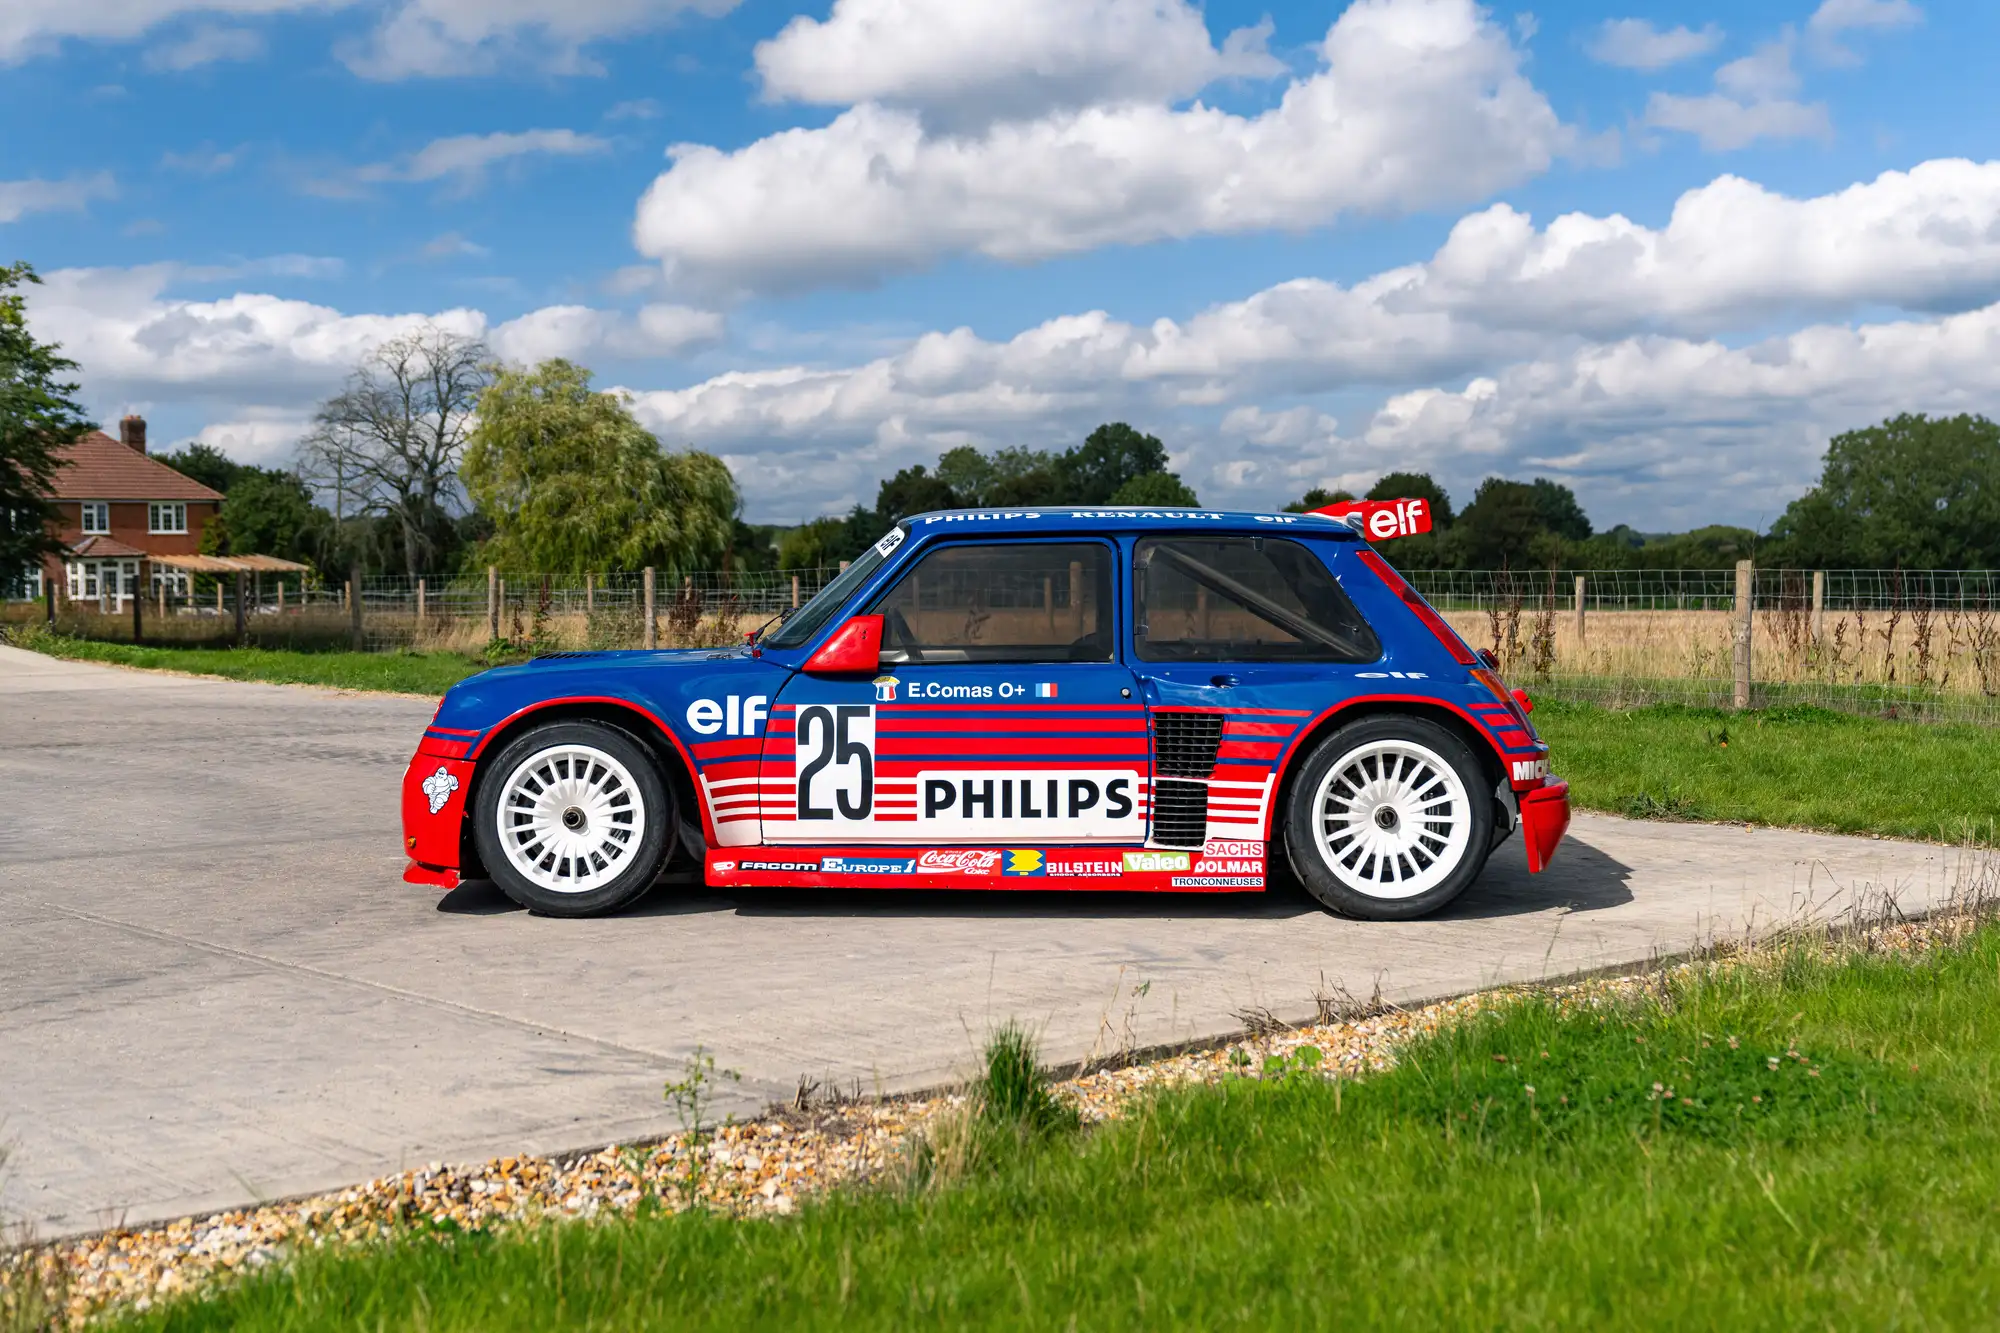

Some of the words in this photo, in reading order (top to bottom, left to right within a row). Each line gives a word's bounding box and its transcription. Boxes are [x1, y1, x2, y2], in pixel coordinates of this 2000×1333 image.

[925, 513, 1041, 524] PHILIPS
[1071, 511, 1225, 520] RENAULT
[1369, 500, 1423, 538] elf
[1354, 671, 1430, 680] elf
[908, 682, 993, 698] E.Comas
[999, 682, 1026, 698] O+
[686, 695, 768, 735] elf
[797, 705, 874, 821] 25
[925, 778, 1133, 819] PHILIPS
[1205, 843, 1262, 855] SACHS
[919, 850, 1002, 868] Coca-Cola
[1124, 853, 1188, 870] Valeo
[1046, 862, 1123, 873] BILSTEIN
[1194, 861, 1263, 873] DOLMAR
[1173, 877, 1262, 886] TRONCONNEUSES
